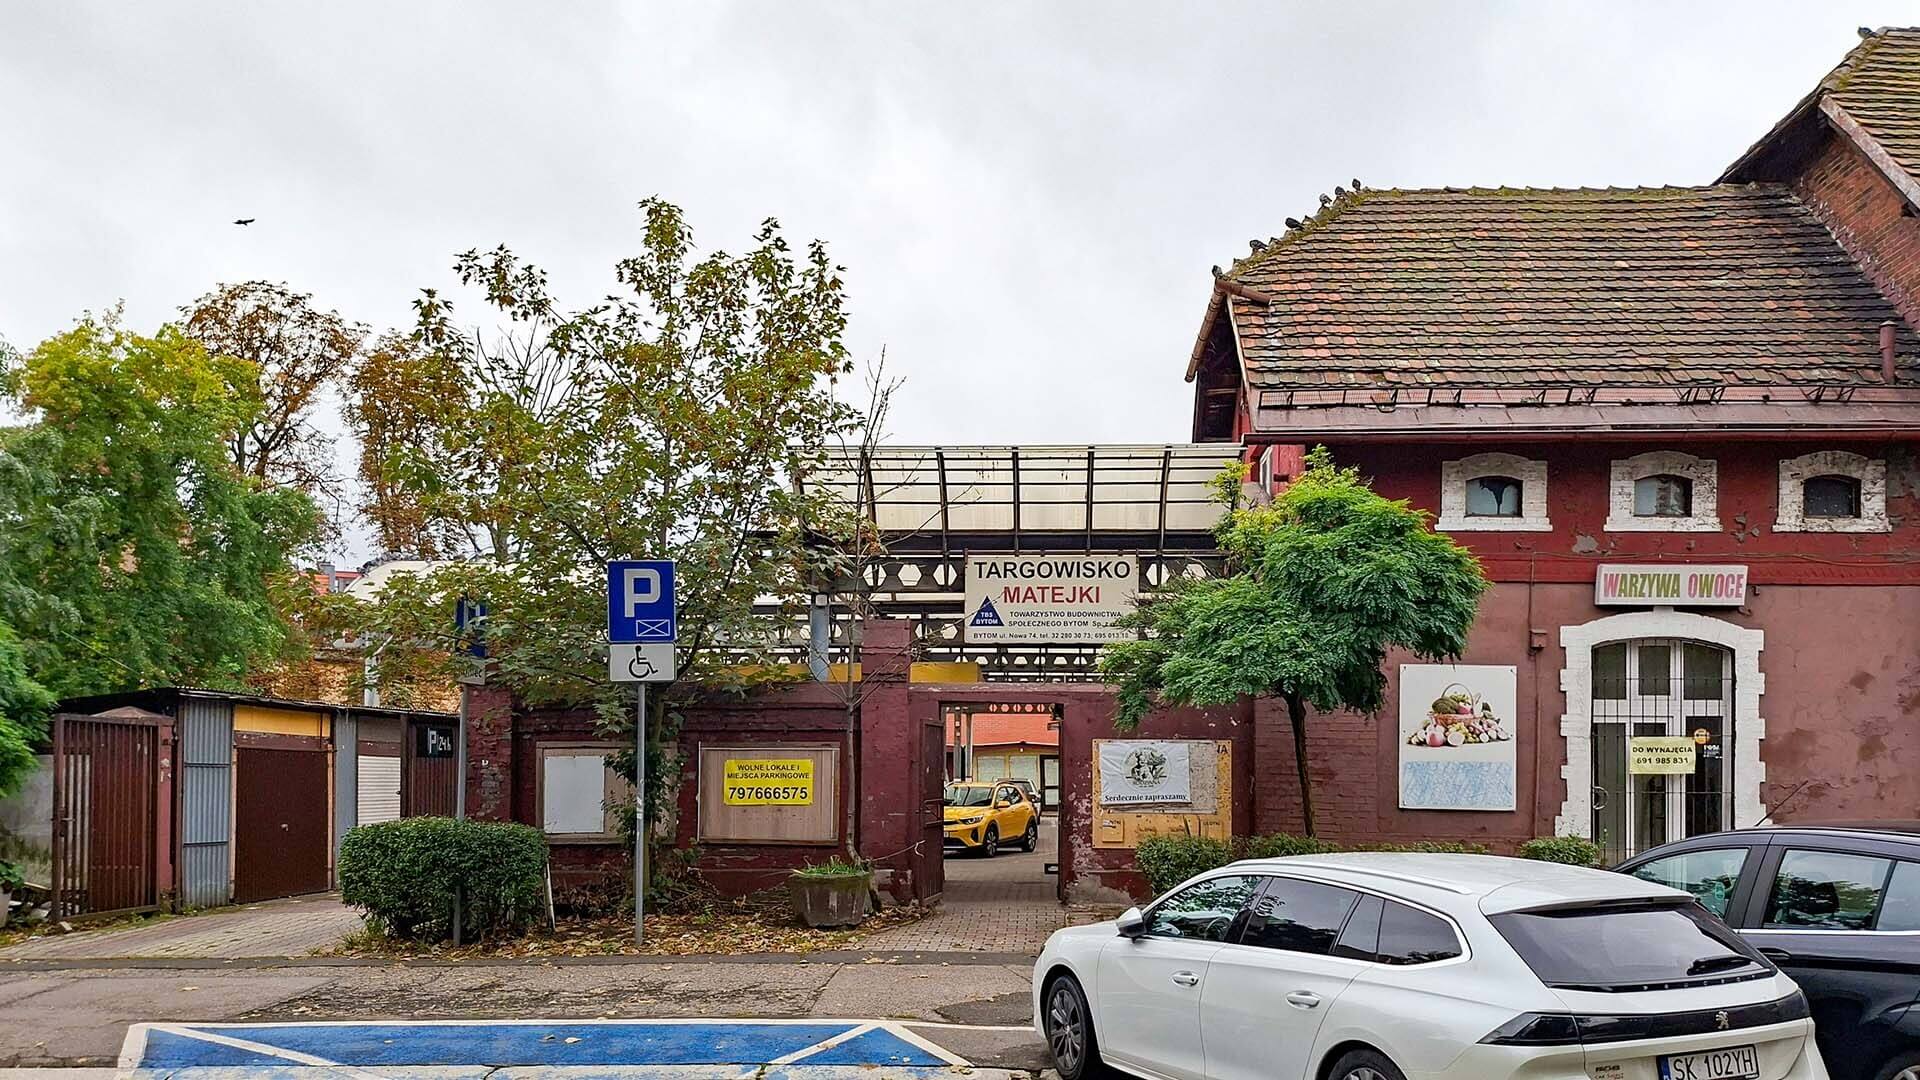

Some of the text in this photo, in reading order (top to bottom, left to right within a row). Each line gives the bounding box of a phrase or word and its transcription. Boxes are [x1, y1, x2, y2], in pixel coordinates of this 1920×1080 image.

[974, 561, 1130, 579] TARGOWISKO
[624, 568, 660, 618] P
[1603, 573, 1744, 598] WARZYWA OWOCE
[1003, 586, 1100, 604] MATEJKI
[729, 787, 808, 800] 797666575
[1144, 794, 1187, 802] zapraszamy
[1673, 1050, 1754, 1080] SK 102YH
